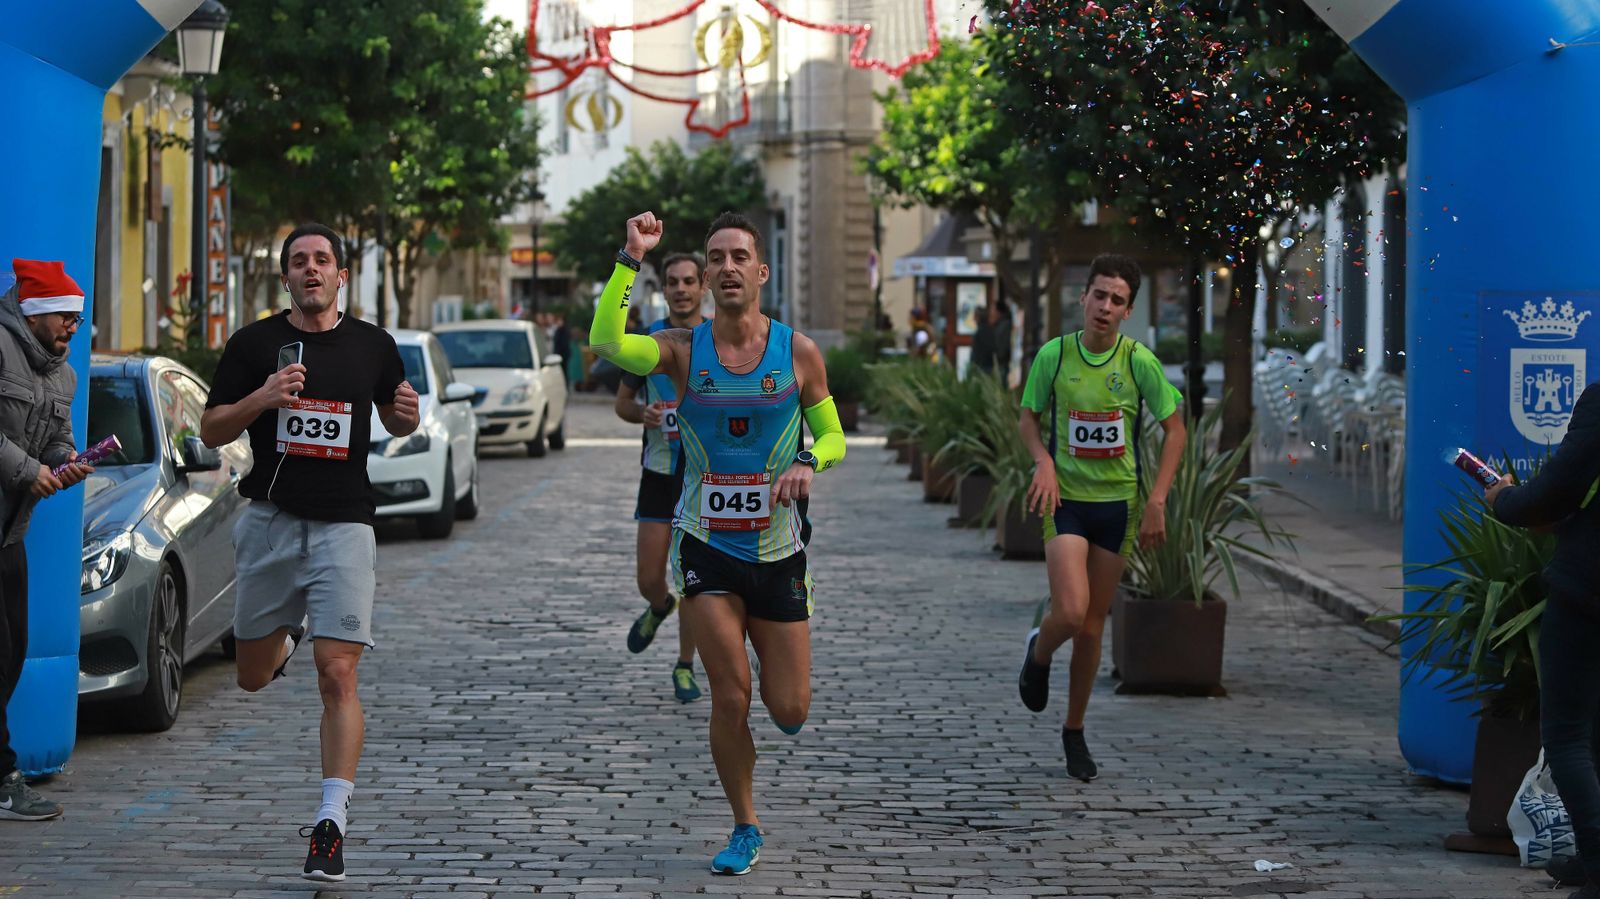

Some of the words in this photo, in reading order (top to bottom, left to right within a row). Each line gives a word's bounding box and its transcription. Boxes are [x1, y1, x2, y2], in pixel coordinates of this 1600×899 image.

[287, 416, 341, 440] 039
[1075, 426, 1118, 443] 043
[703, 473, 713, 483] II
[709, 492, 761, 512] 045
